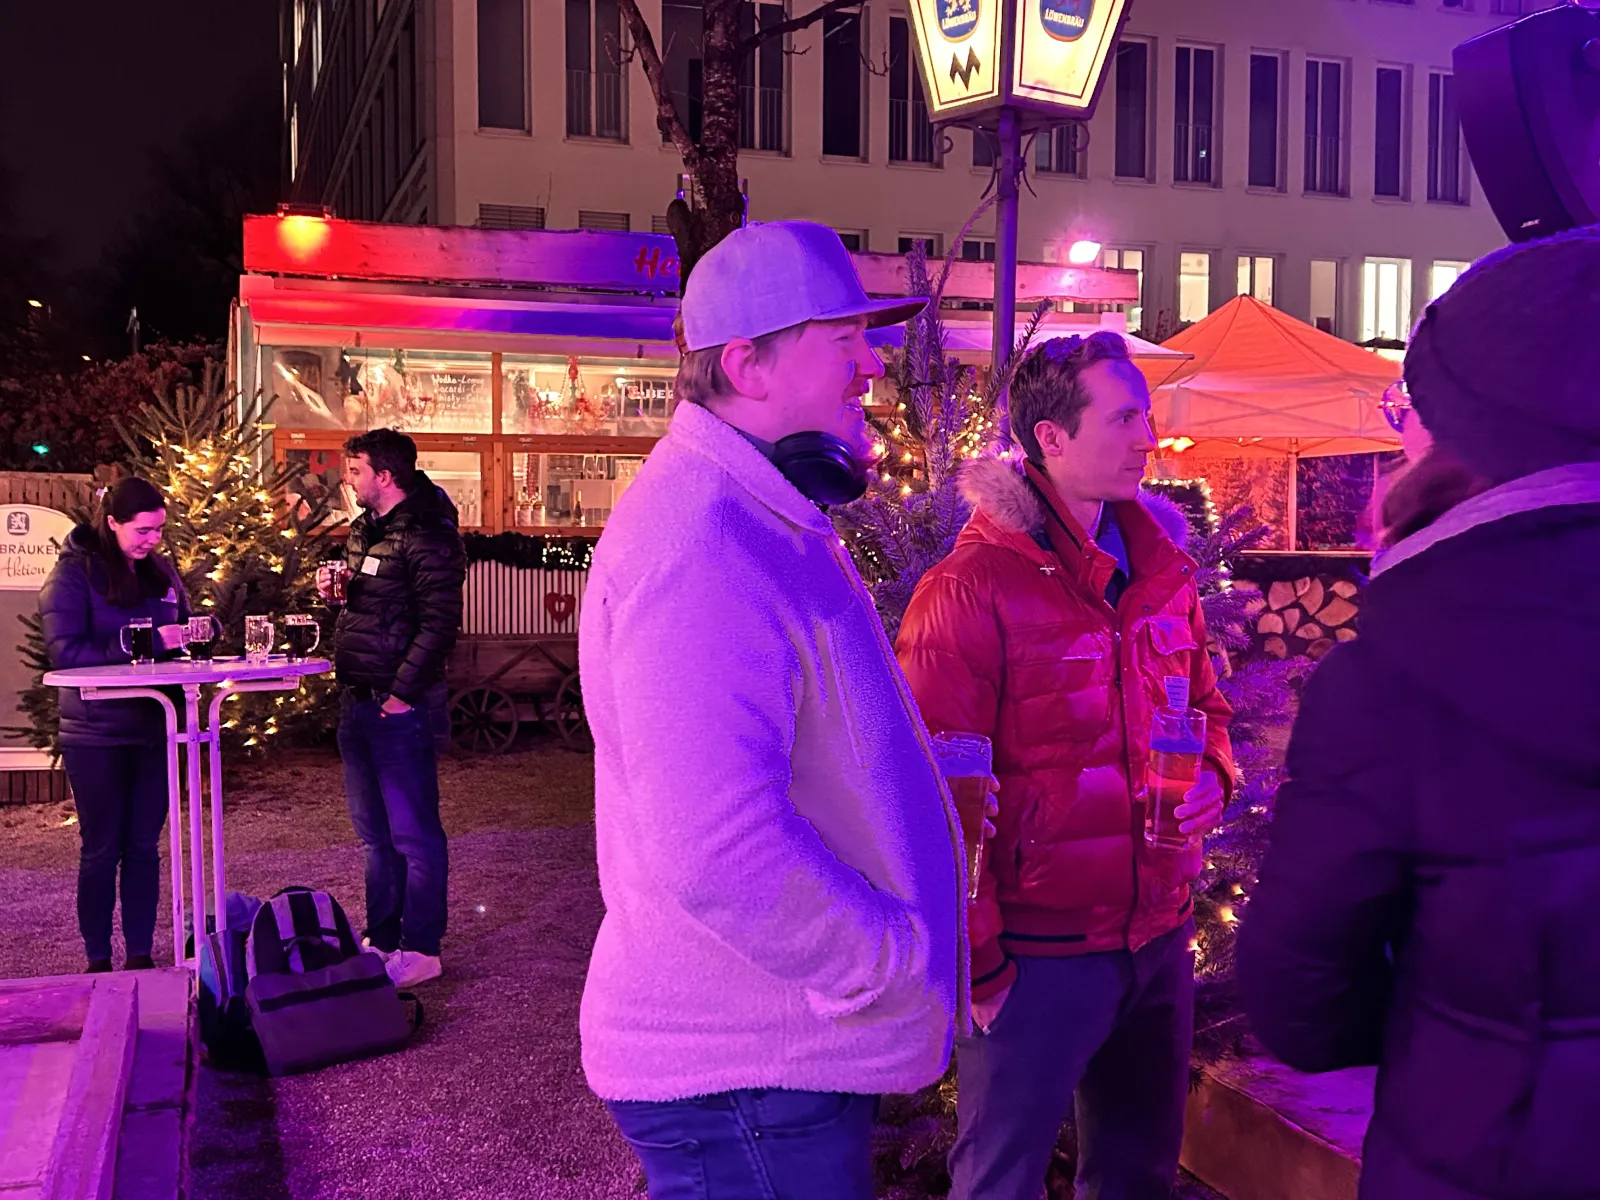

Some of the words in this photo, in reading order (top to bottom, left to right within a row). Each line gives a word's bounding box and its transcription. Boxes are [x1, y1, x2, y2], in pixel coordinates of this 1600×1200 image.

[941, 10, 977, 30] LÖWENBRÄU
[1044, 8, 1085, 28] LÖWENBRÄU
[633, 246, 681, 279] He
